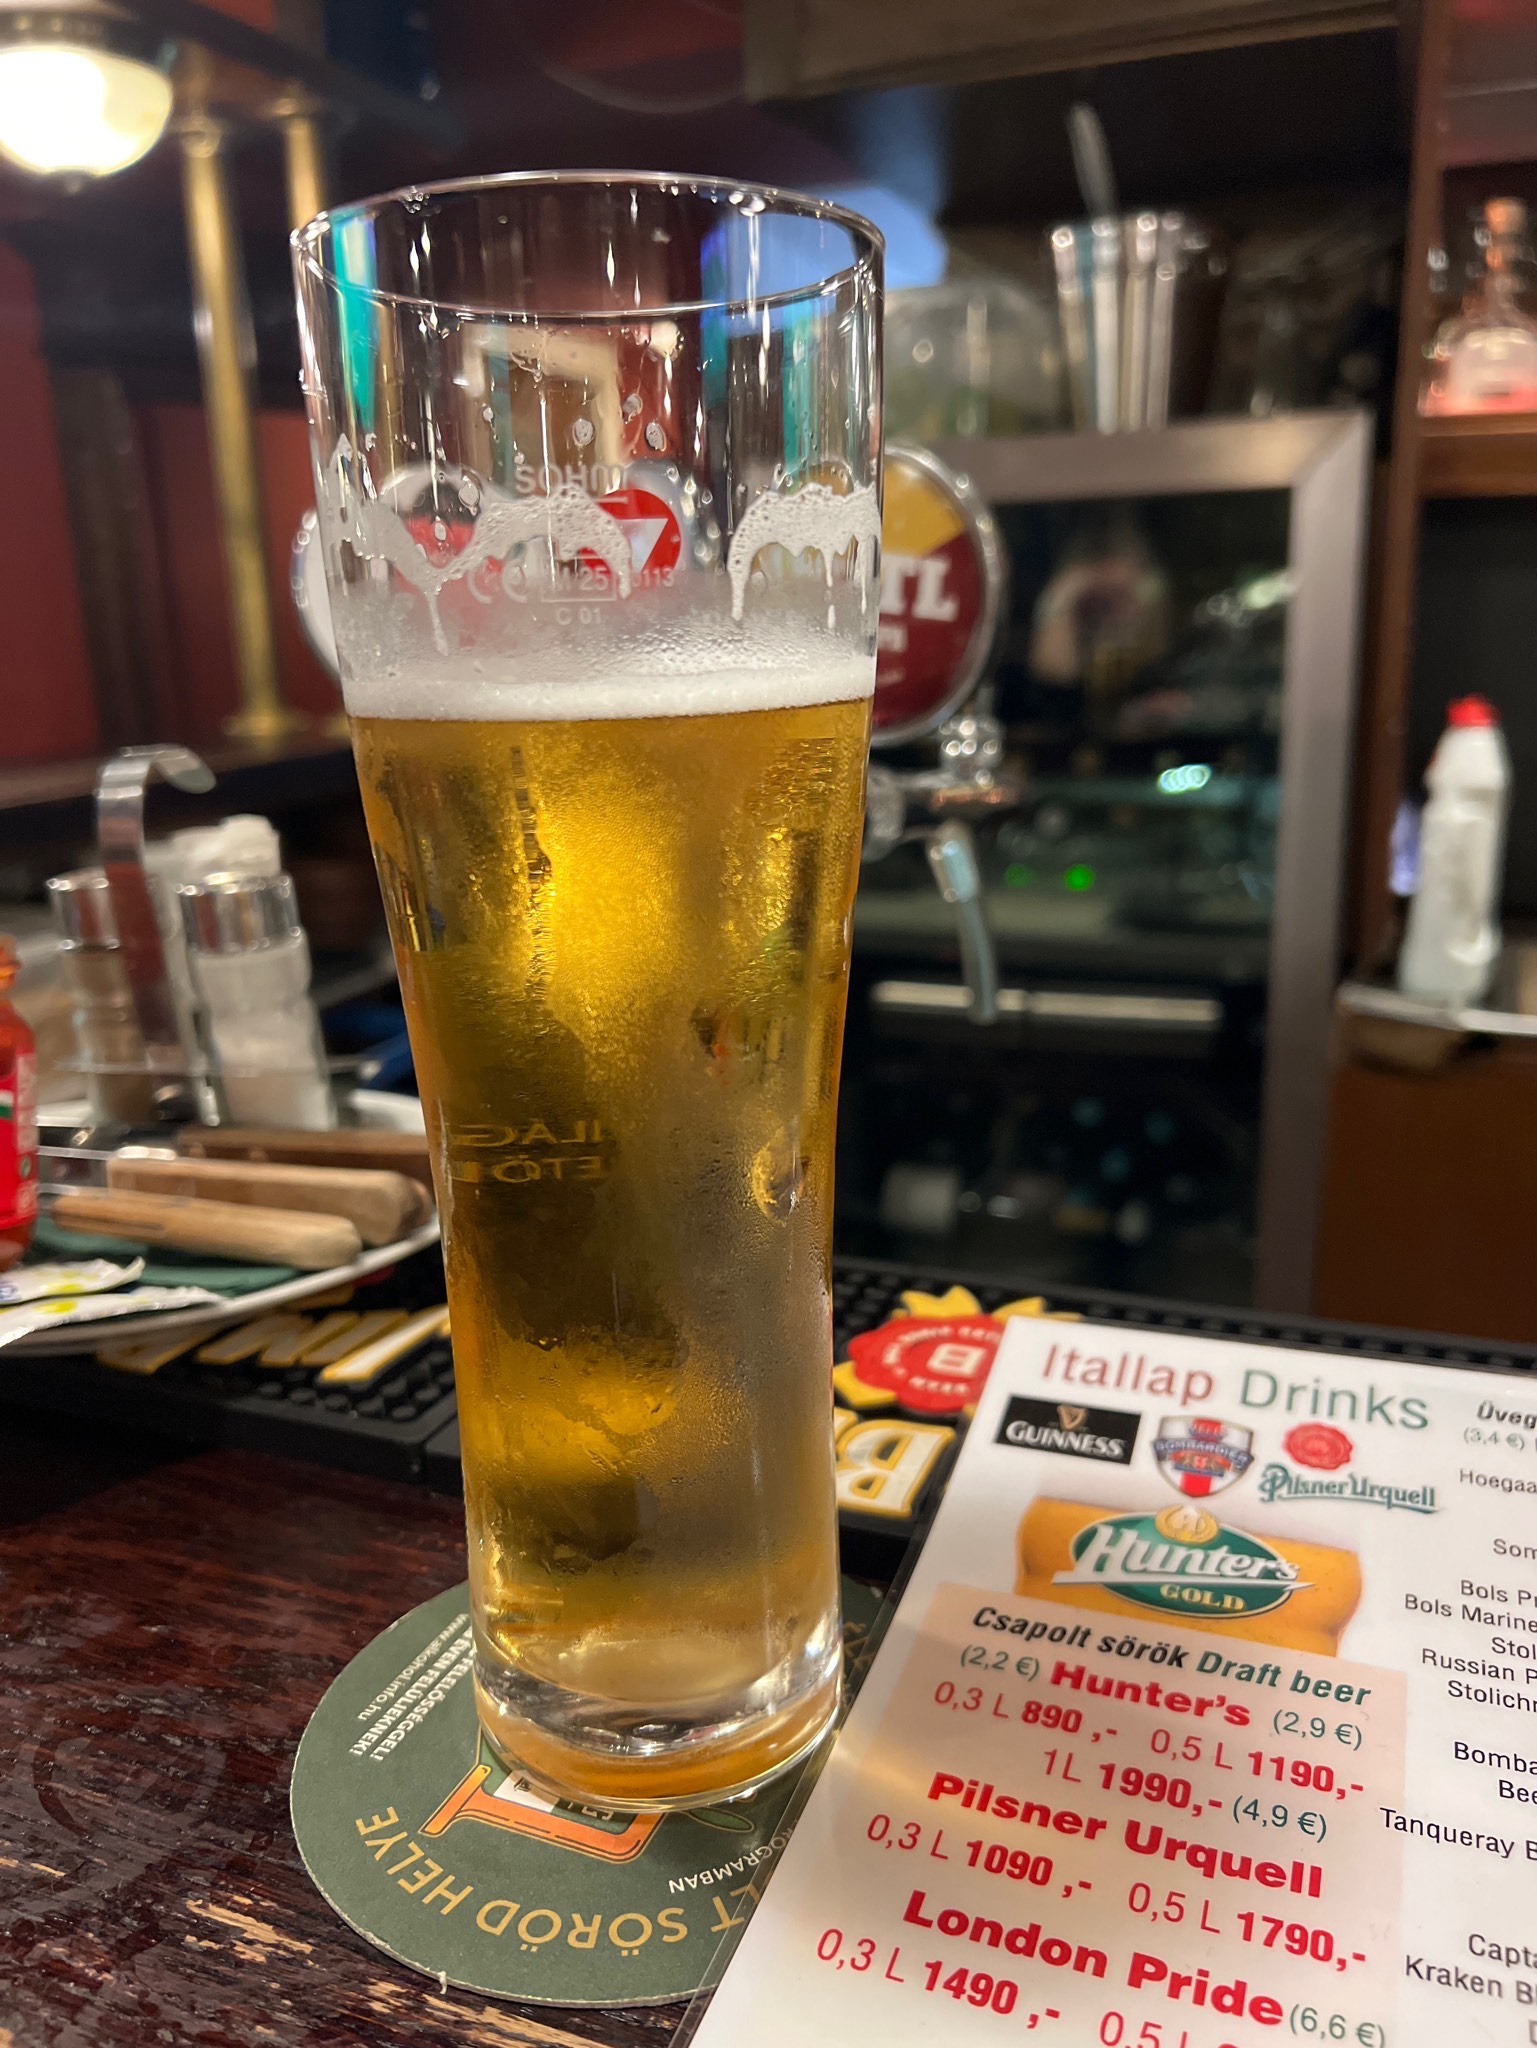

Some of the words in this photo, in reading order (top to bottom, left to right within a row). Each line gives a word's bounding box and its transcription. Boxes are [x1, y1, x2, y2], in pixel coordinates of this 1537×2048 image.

[1042, 1342, 1214, 1407] Itallap
[1240, 1369, 1430, 1429] Drinks
[1006, 1420, 1128, 1459] GUINNESS
[1259, 1462, 1350, 1504] Pilsner
[1350, 1472, 1436, 1509] Urquell
[1160, 1584, 1247, 1611] GOLD
[1405, 1593, 1452, 1617] Bols
[1462, 1604, 1537, 1633] Marine
[1461, 1579, 1508, 1603] Bols
[973, 1607, 1092, 1648] Csapolt
[1097, 1635, 1190, 1668] sörök
[1196, 1650, 1282, 1687] Draft
[1289, 1670, 1371, 1705] beer
[1422, 1648, 1515, 1681] Russian
[960, 1644, 1009, 1672] (2,2
[1016, 1655, 1040, 1682] €)
[1273, 1709, 1326, 1738] (2,9
[1335, 1723, 1362, 1751] €)
[934, 1681, 983, 1711] 0,3
[992, 1693, 1009, 1719] L
[1021, 1700, 1083, 1733] 890
[1150, 1728, 1202, 1762] 0,5
[1215, 1742, 1233, 1770] L
[1248, 1751, 1364, 1800] 1190,-
[927, 1771, 1107, 1840] Pilsner
[1124, 1819, 1323, 1898] Urquell
[1099, 1763, 1222, 1817] 1990,-
[1233, 1795, 1288, 1827] (4,9
[1297, 1811, 1327, 1843] €)
[1379, 1807, 1515, 1859] Tanqueray
[355, 1806, 474, 1914] HELYE
[867, 1814, 921, 1850] 0,3
[930, 1829, 948, 1860] L
[966, 1840, 1053, 1886] 1090
[1128, 1882, 1186, 1923] 0,5
[1200, 1899, 1220, 1934] L
[1237, 1911, 1366, 1972] 1790,-
[476, 1899, 688, 1958] SÖRÖD
[903, 1889, 1108, 1978] London
[1127, 1951, 1283, 2026] Pride
[1290, 2003, 1346, 2040] (6,6
[817, 1928, 876, 1971] 0,3
[885, 1947, 904, 1983] L
[924, 1960, 1019, 2014] 1490
[1406, 1955, 1503, 1998] Kraken
